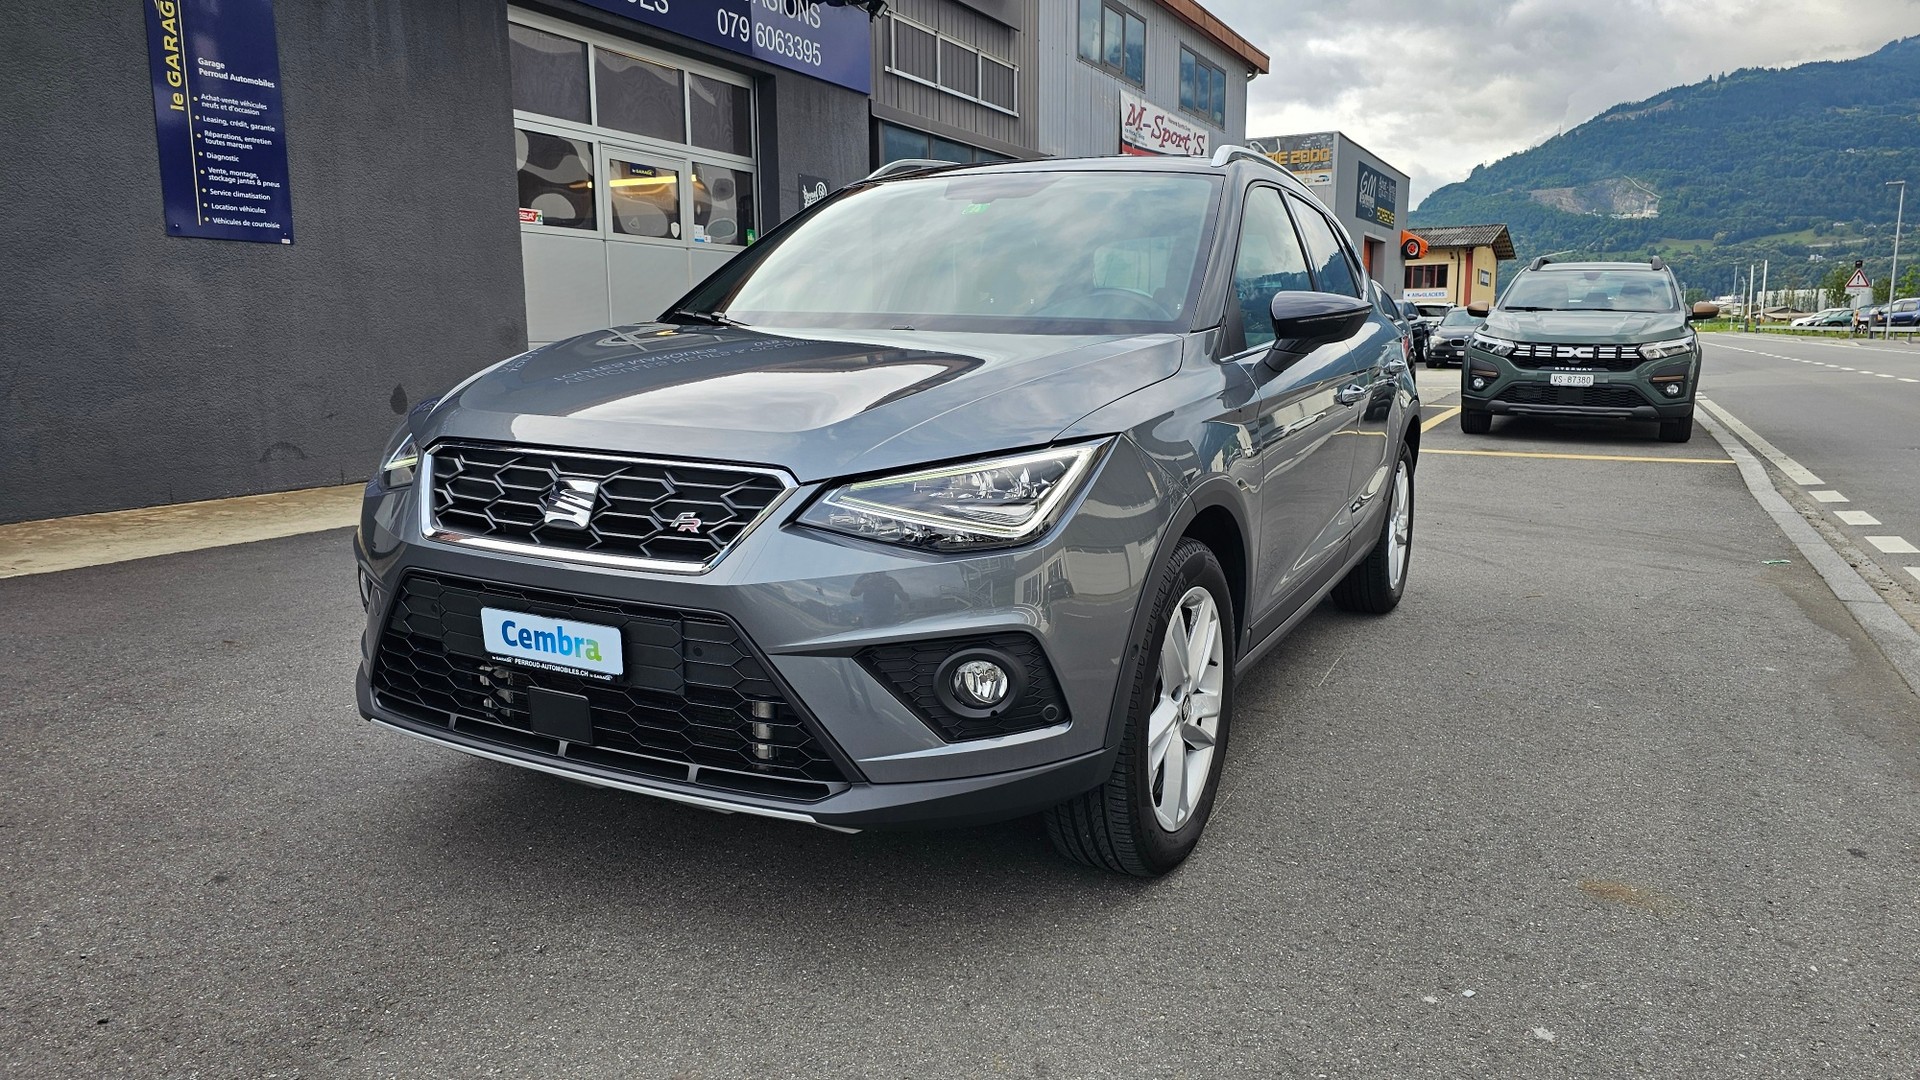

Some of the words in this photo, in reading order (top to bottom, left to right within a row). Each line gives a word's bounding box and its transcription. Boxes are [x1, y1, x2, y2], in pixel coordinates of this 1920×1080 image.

[717, 8, 750, 42] 079
[755, 22, 821, 66] 6063395
[197, 57, 225, 69] Garage
[198, 68, 228, 80] Perroud
[230, 74, 275, 88] Automobiles
[171, 93, 185, 111] le
[201, 93, 238, 106] Achat-vente
[240, 100, 267, 110] véhicules
[201, 101, 219, 109] neufs
[228, 106, 260, 115] d'occasion
[202, 115, 228, 126] Leasing,
[250, 123, 276, 132] garantie
[205, 137, 225, 146] toutes
[226, 141, 253, 150] marques
[244, 136, 272, 145] entretien
[206, 152, 240, 162] Diagnostic
[1290, 148, 1330, 164] 2000
[207, 166, 228, 176] Vente,
[229, 169, 259, 179] montage,
[208, 174, 236, 184] stockage
[237, 176, 256, 185] jantes
[209, 188, 232, 197] Service
[232, 190, 271, 201] climatisation
[211, 202, 238, 211] Location
[238, 205, 267, 214] véhicules
[212, 217, 242, 226] Véhicules
[251, 221, 280, 229] courtoisie
[501, 619, 602, 662] Cembra
